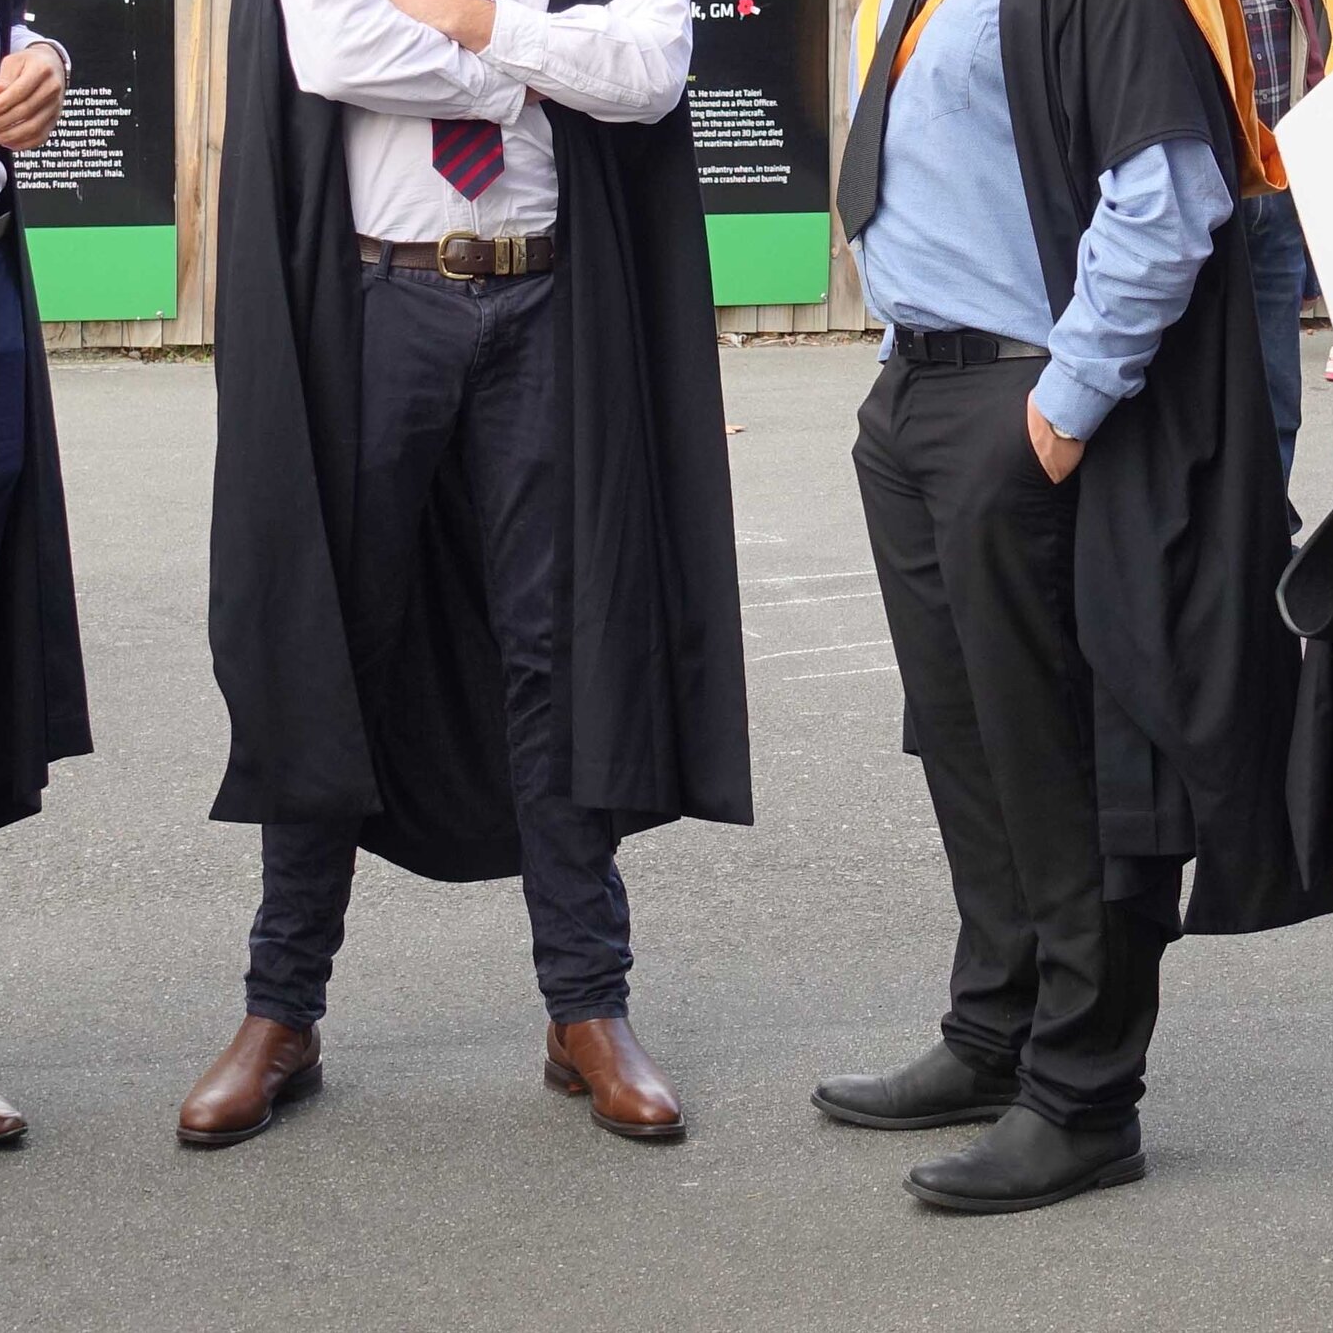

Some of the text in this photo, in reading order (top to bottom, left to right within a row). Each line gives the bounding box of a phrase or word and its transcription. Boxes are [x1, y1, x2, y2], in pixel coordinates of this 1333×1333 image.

[710, 3, 734, 18] GM
[84, 119, 109, 128] posted
[58, 129, 88, 137] Warrant
[61, 140, 86, 148] August
[82, 149, 107, 158] Stirling
[14, 160, 40, 170] dnight.
[42, 160, 55, 168] The
[84, 159, 112, 167] crashed
[33, 170, 68, 179] personnel
